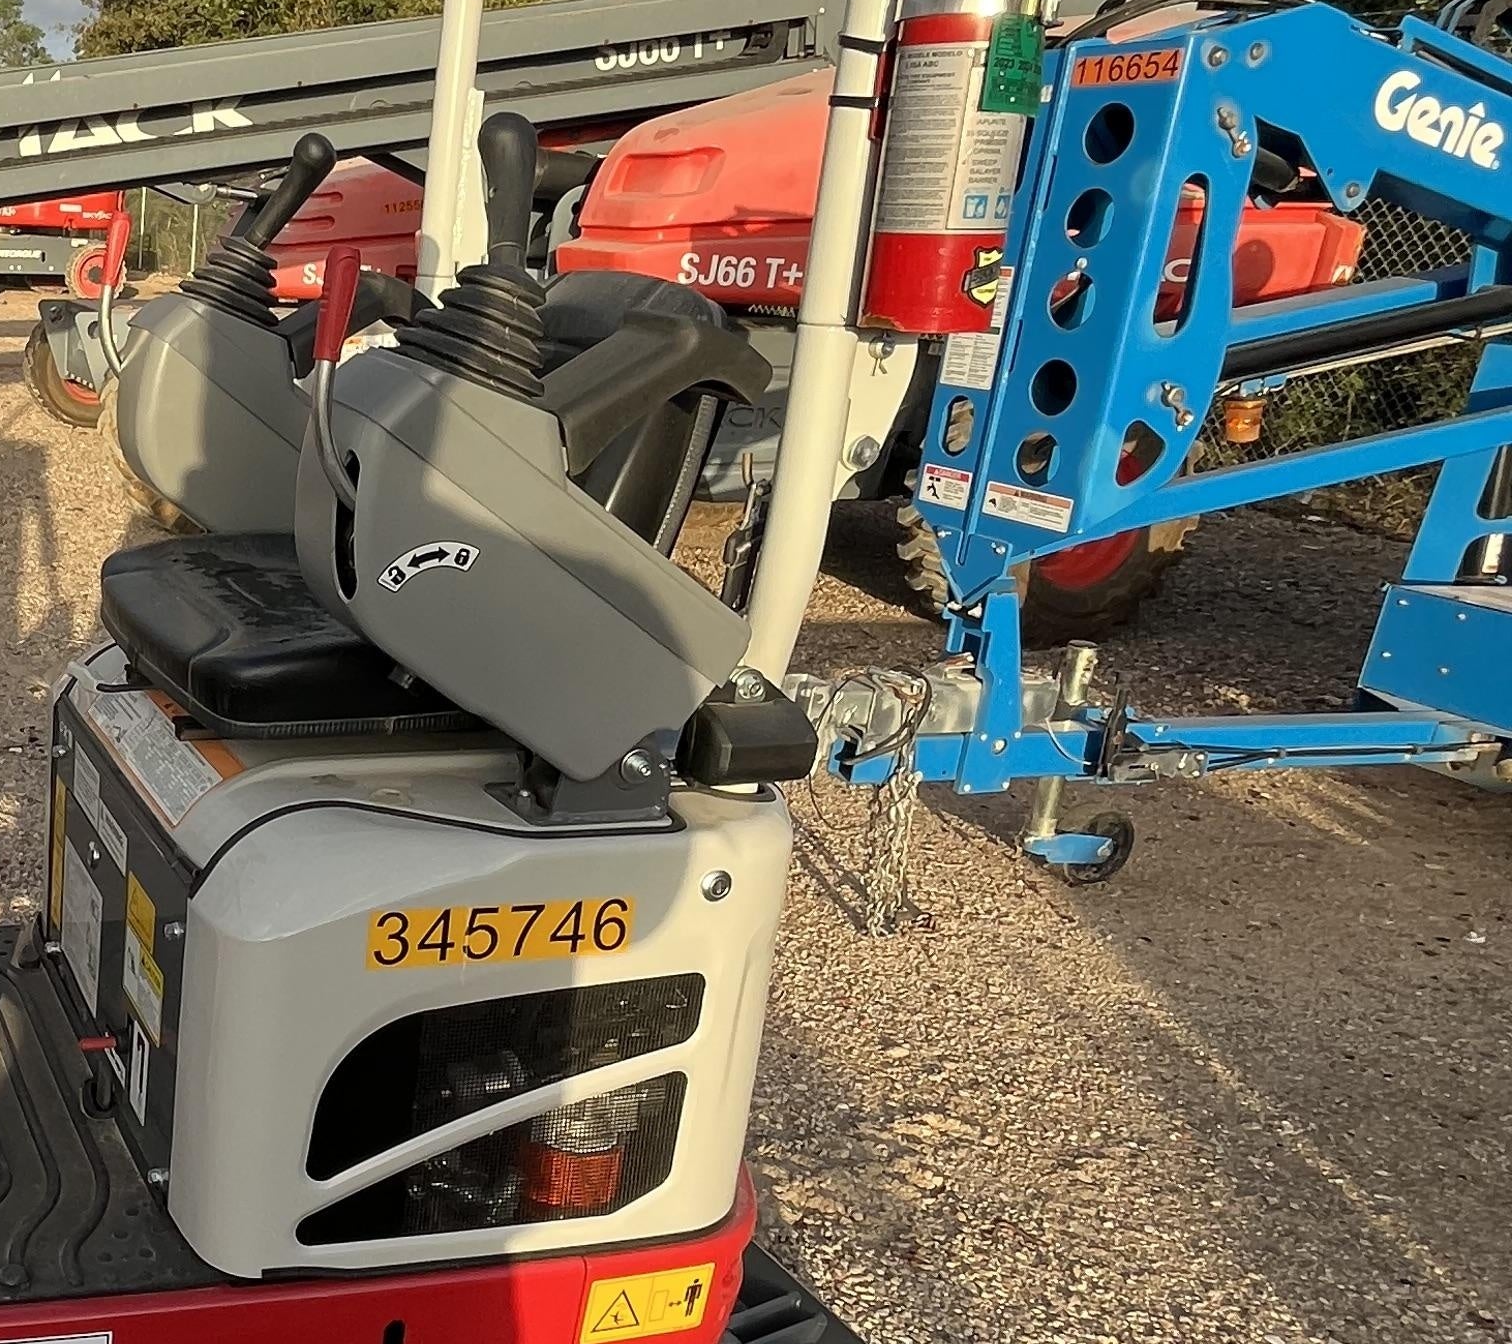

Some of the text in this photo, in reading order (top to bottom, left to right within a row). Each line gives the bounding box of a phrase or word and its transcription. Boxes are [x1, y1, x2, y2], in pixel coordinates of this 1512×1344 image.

[1076, 49, 1180, 84] 116654
[1374, 70, 1505, 170] Genie
[384, 199, 423, 213] 11255
[677, 251, 804, 289] SJ66 T+
[373, 898, 629, 966] 345746
